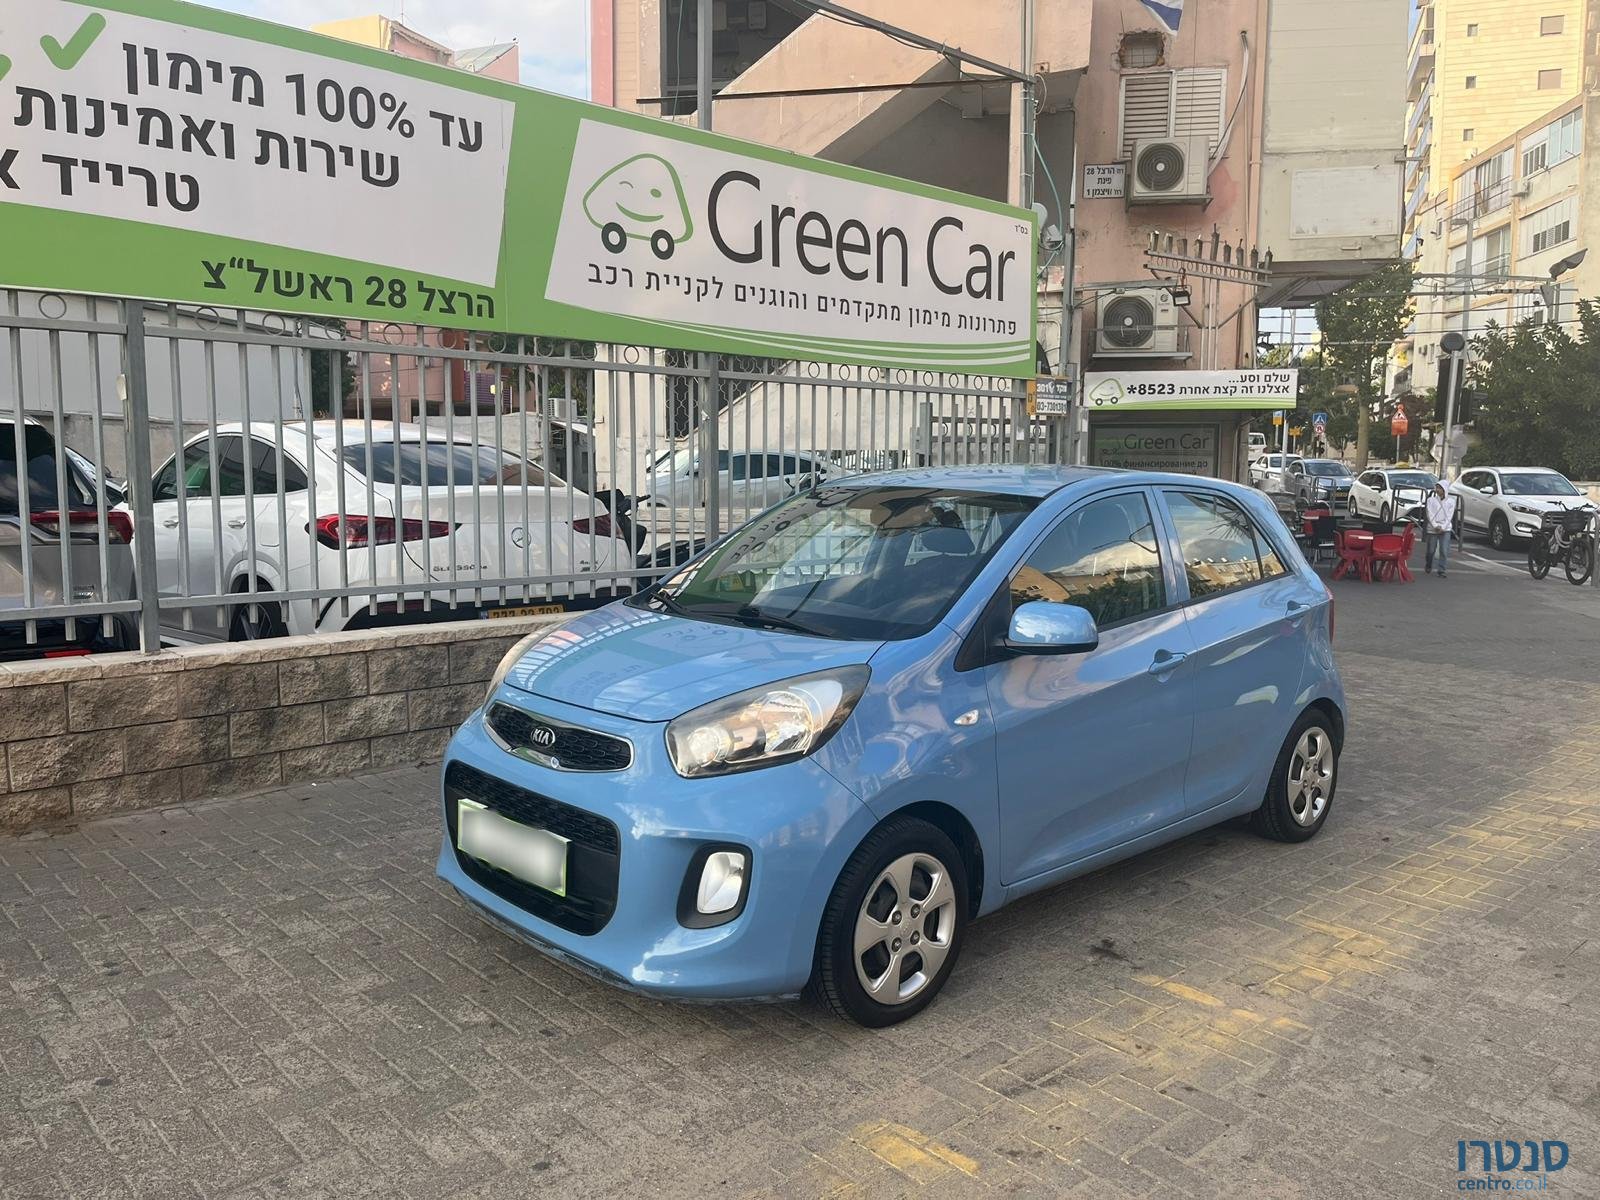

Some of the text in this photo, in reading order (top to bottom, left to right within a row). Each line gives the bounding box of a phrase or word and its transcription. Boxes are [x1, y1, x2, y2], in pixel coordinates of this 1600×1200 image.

[123, 43, 482, 152] עד 100% מימון
[14, 86, 399, 187] שירות ואמינות
[1097, 166, 1115, 175] הרצל
[42, 154, 199, 211] טרייד
[708, 170, 1015, 301] Green Car
[365, 276, 406, 308] 28
[418, 280, 494, 318] הרצל
[588, 264, 1016, 335] פתרונות מימון מתקדמים והוגנים לקניית רכב
[1264, 373, 1290, 383] שלם
[1179, 385, 1210, 395] אחרת
[1213, 385, 1237, 396] קצת
[1241, 385, 1254, 394] זה
[1257, 383, 1290, 394] אצלנו
[1124, 433, 1209, 450] Green Car
[533, 728, 549, 744] KIA
